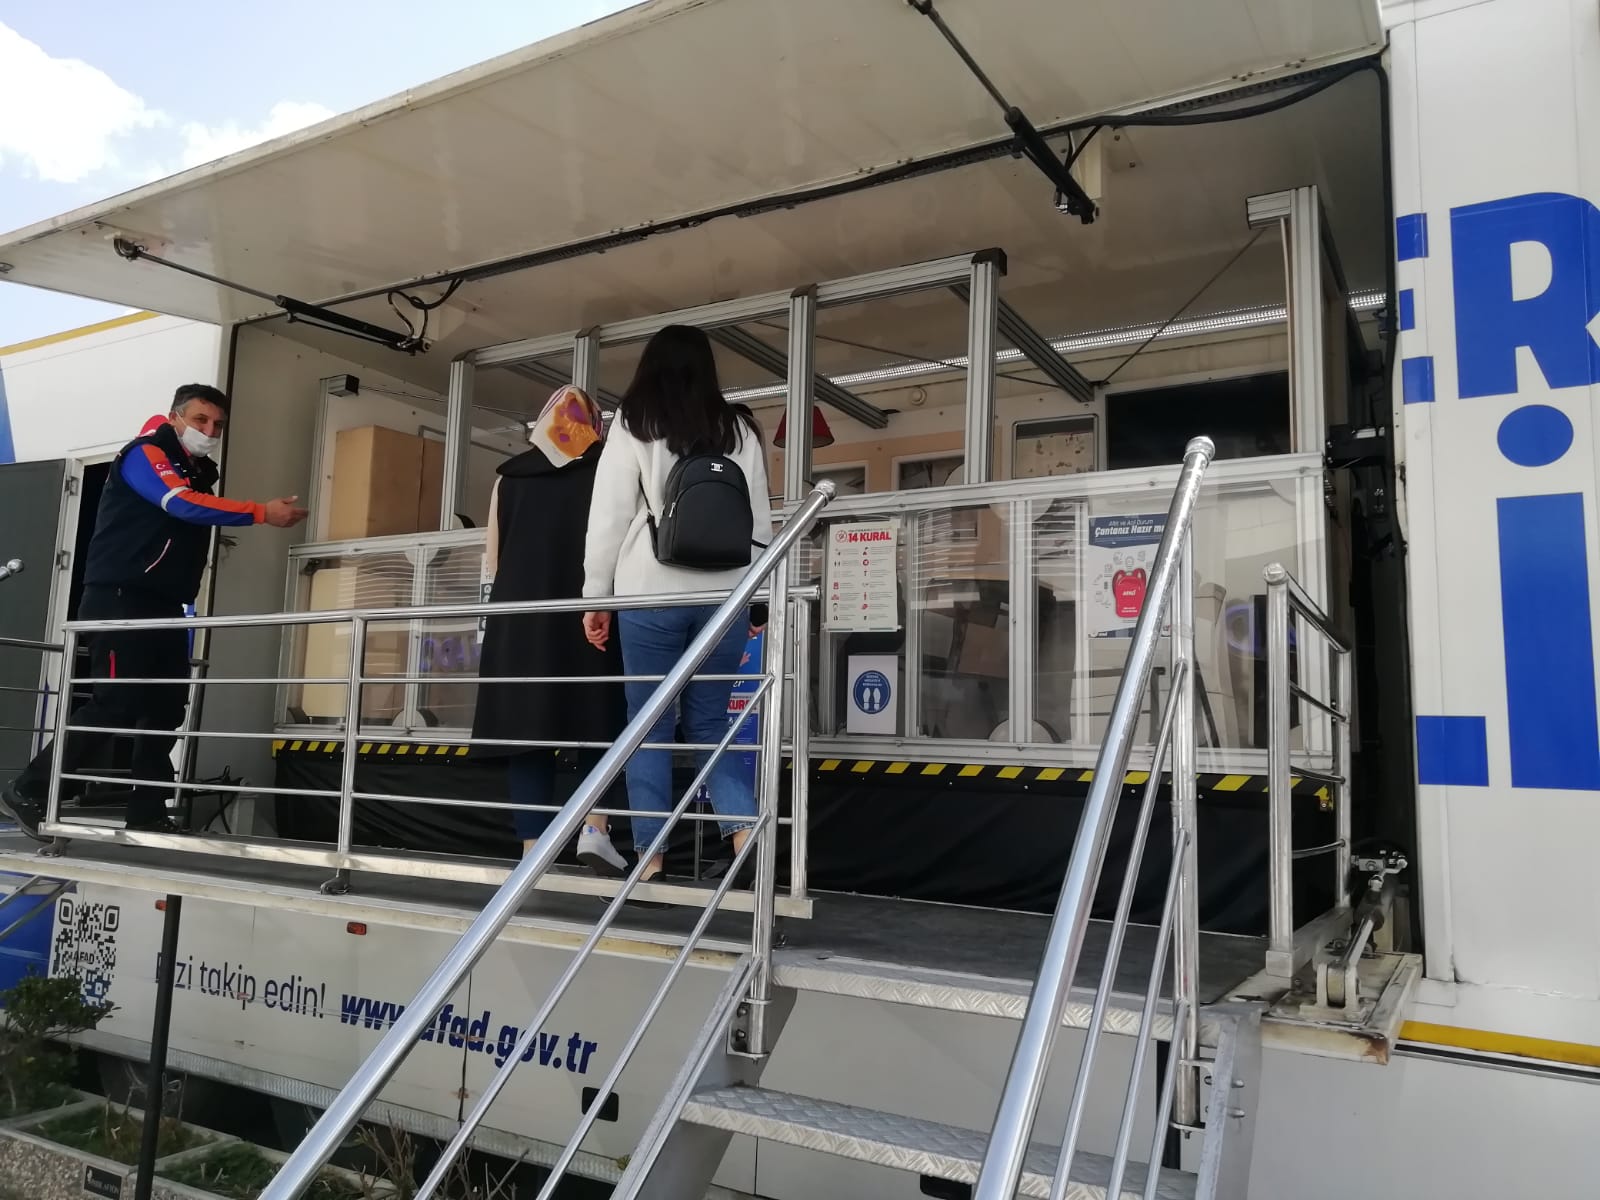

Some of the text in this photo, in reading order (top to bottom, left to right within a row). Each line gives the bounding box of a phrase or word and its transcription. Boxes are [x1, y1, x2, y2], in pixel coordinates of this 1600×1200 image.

[1397, 192, 1600, 404] R
[848, 531, 892, 543] 14 KURAL
[1095, 527, 1130, 537] Çantanız
[1131, 525, 1152, 534] Hazır
[728, 699, 751, 710] KUR
[155, 952, 598, 1075] zi takip edin! wwfad.gv.tr
